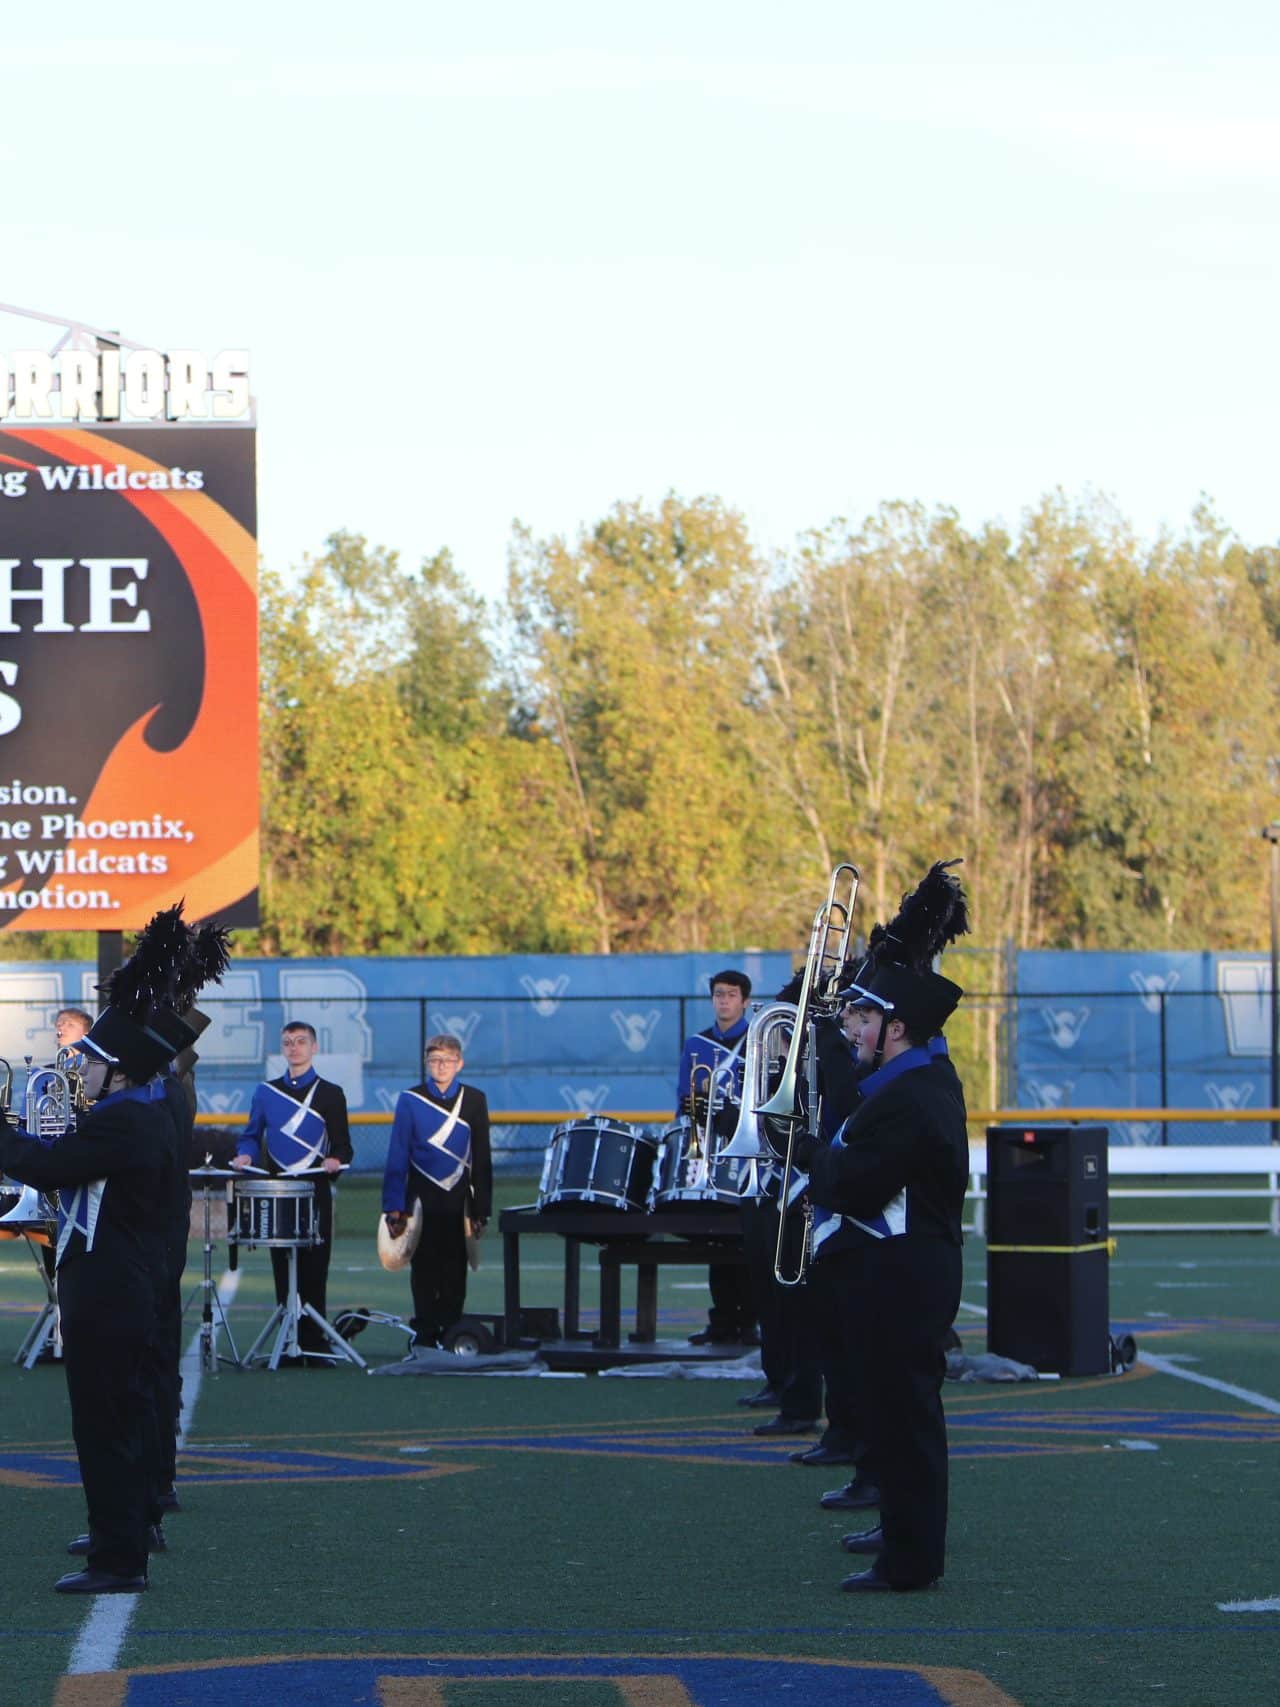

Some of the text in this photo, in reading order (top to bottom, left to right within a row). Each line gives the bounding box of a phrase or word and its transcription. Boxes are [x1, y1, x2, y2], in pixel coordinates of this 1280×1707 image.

[36, 463, 204, 490] Wildcats
[41, 814, 194, 842] Phoenix,
[15, 848, 168, 874] Wildcats
